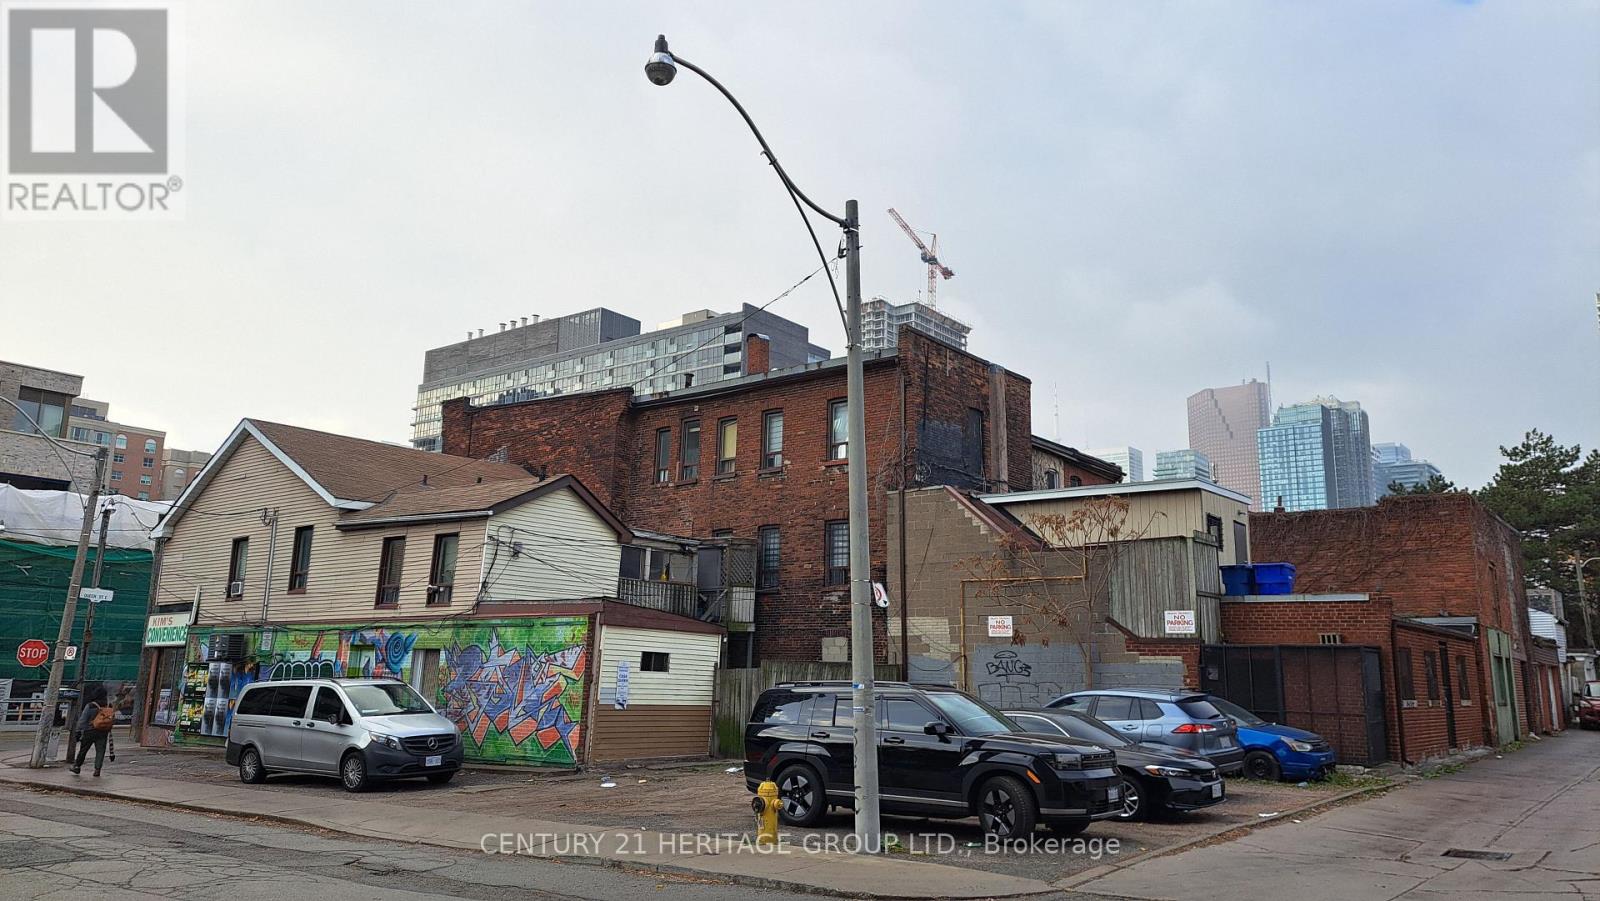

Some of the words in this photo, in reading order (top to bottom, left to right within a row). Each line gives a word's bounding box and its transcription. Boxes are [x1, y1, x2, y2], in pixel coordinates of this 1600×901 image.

[152, 617, 173, 626] KIM'S
[147, 625, 187, 642] CONVENIENCE
[19, 647, 47, 659] STOP
